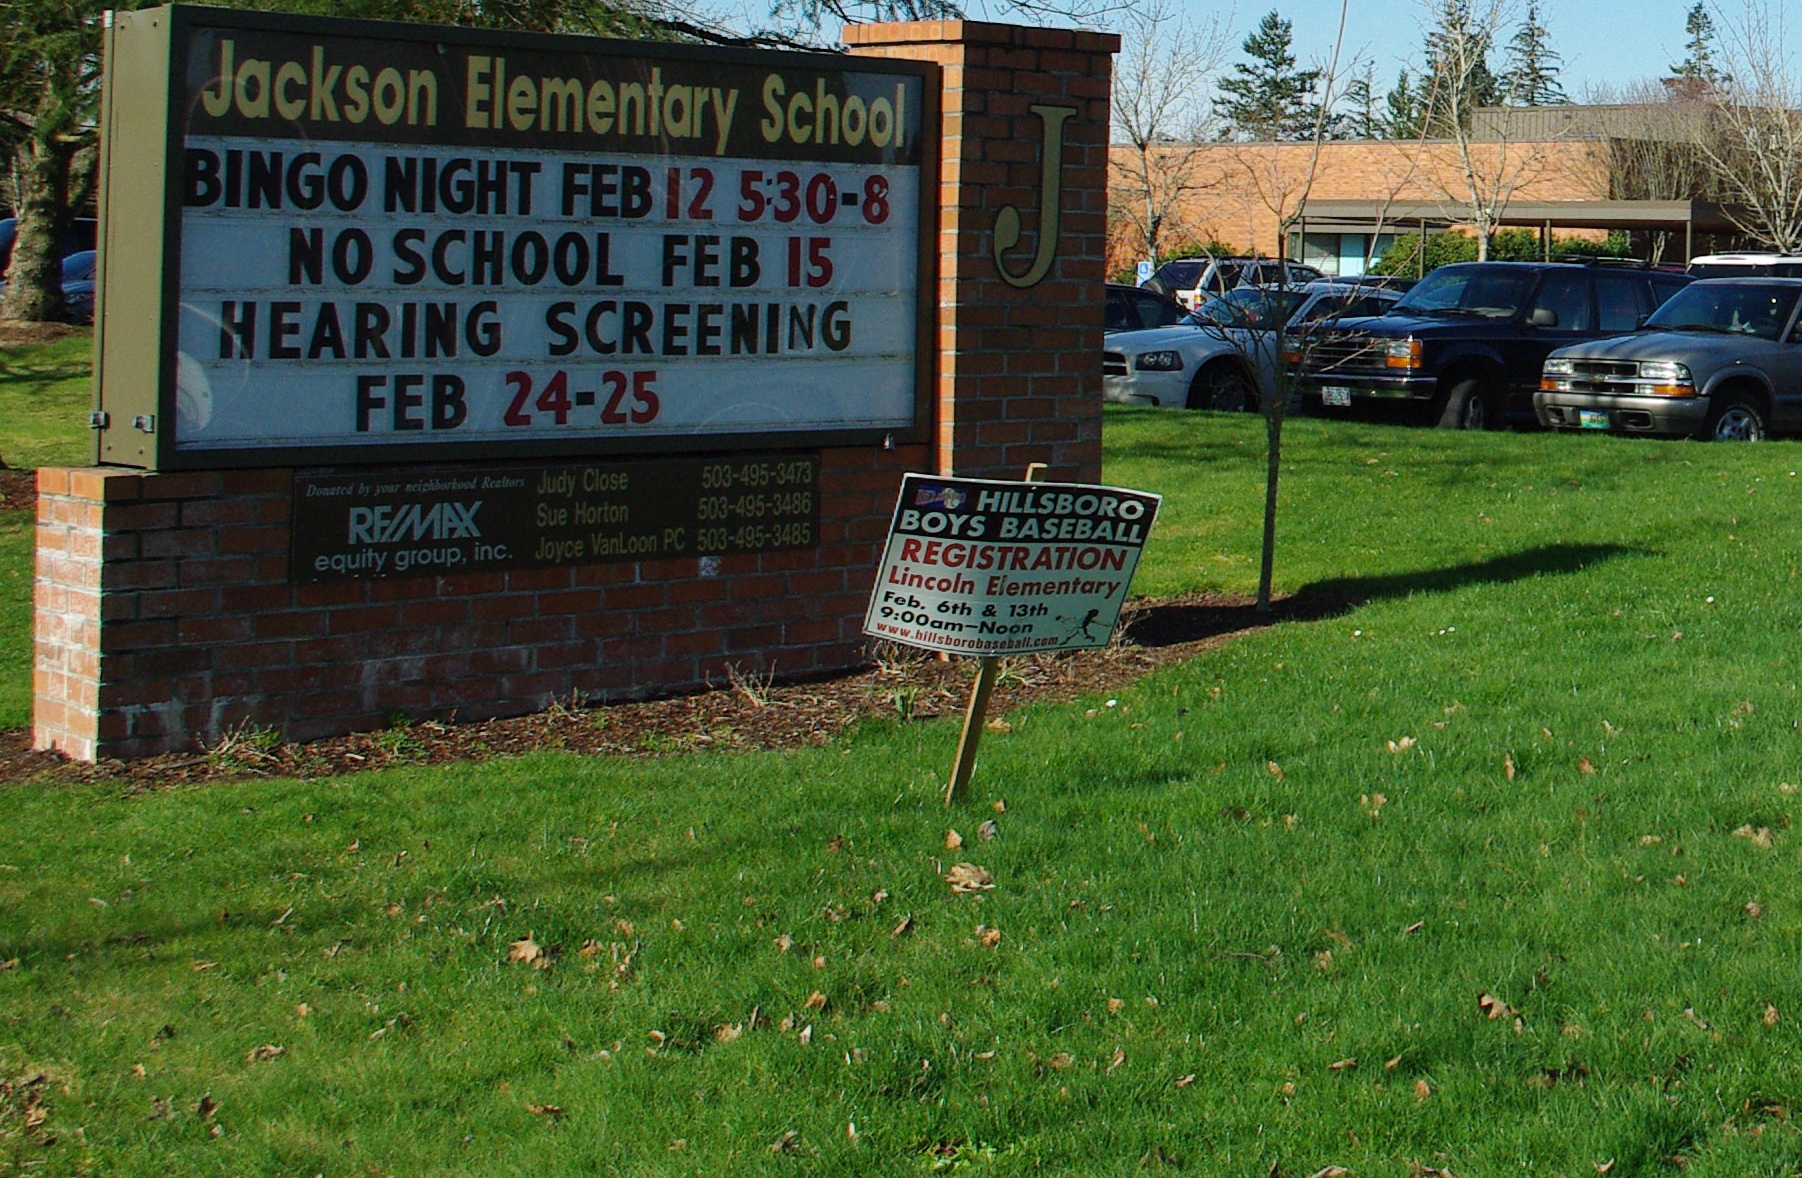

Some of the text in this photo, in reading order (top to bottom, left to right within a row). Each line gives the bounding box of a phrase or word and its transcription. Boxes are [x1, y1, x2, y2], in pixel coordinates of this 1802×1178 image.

[202, 39, 904, 155] Jackson Elementary School
[184, 148, 369, 211] BINGO
[384, 157, 541, 216] NIGHT
[561, 163, 653, 219] FEB
[666, 167, 714, 220] 12
[993, 104, 1077, 289] J
[289, 227, 834, 288] NO SCHOOL FEB 15
[219, 301, 851, 359] HEARING SCREENING
[356, 370, 660, 432] FEB 24-25
[306, 476, 525, 497] Donated by your neighborhood Realtors
[537, 461, 812, 497] Judy Close 503-495-3473
[536, 492, 811, 527] Sue Horton 503-495-3486
[977, 490, 1145, 520] HILLSBORO
[348, 501, 483, 545] RE/MAX
[900, 509, 1143, 544] BOYS BASEBALL
[314, 542, 513, 574] equity group, inc.
[535, 523, 811, 563] Joyce VanLoon PC 503-495-3485
[901, 538, 1128, 571] REGISTRATION
[888, 565, 1121, 599] Lincoln Elementary
[883, 591, 1049, 617] Feb. 6th & 13th
[876, 622, 1059, 650] www.hillsborobaseball.com
